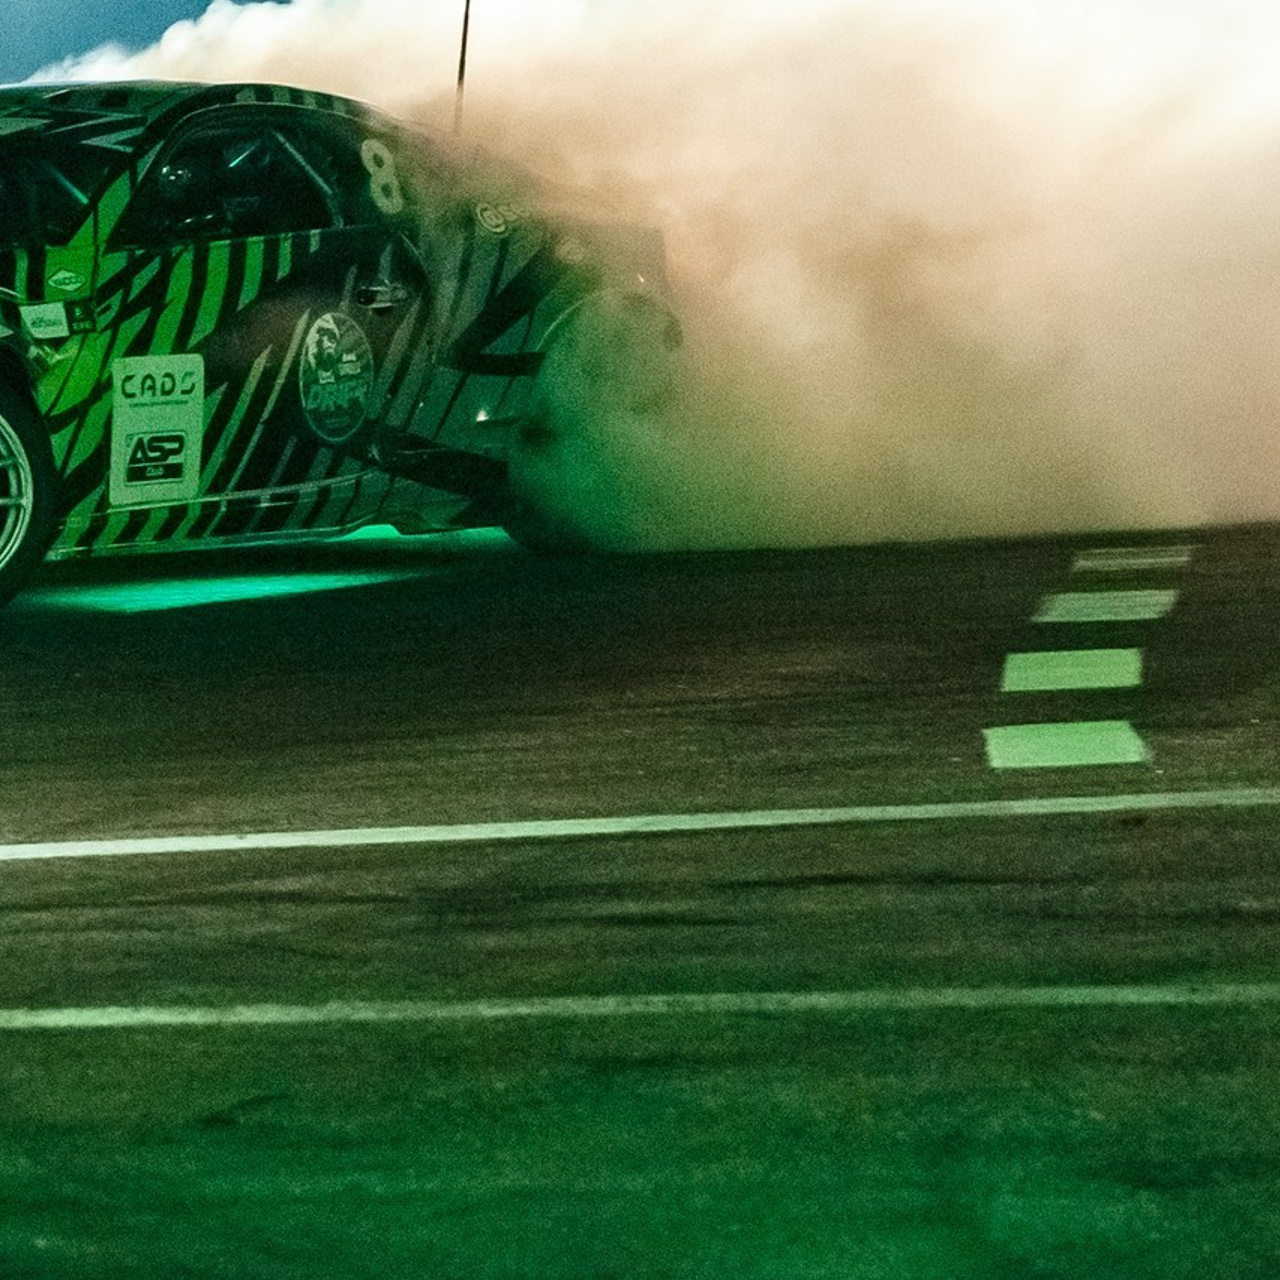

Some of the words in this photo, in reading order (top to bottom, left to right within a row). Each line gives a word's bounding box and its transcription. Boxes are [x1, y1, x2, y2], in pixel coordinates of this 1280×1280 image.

[361, 138, 403, 214] 8
[121, 371, 195, 398] CADS
[129, 435, 185, 464] ASP
